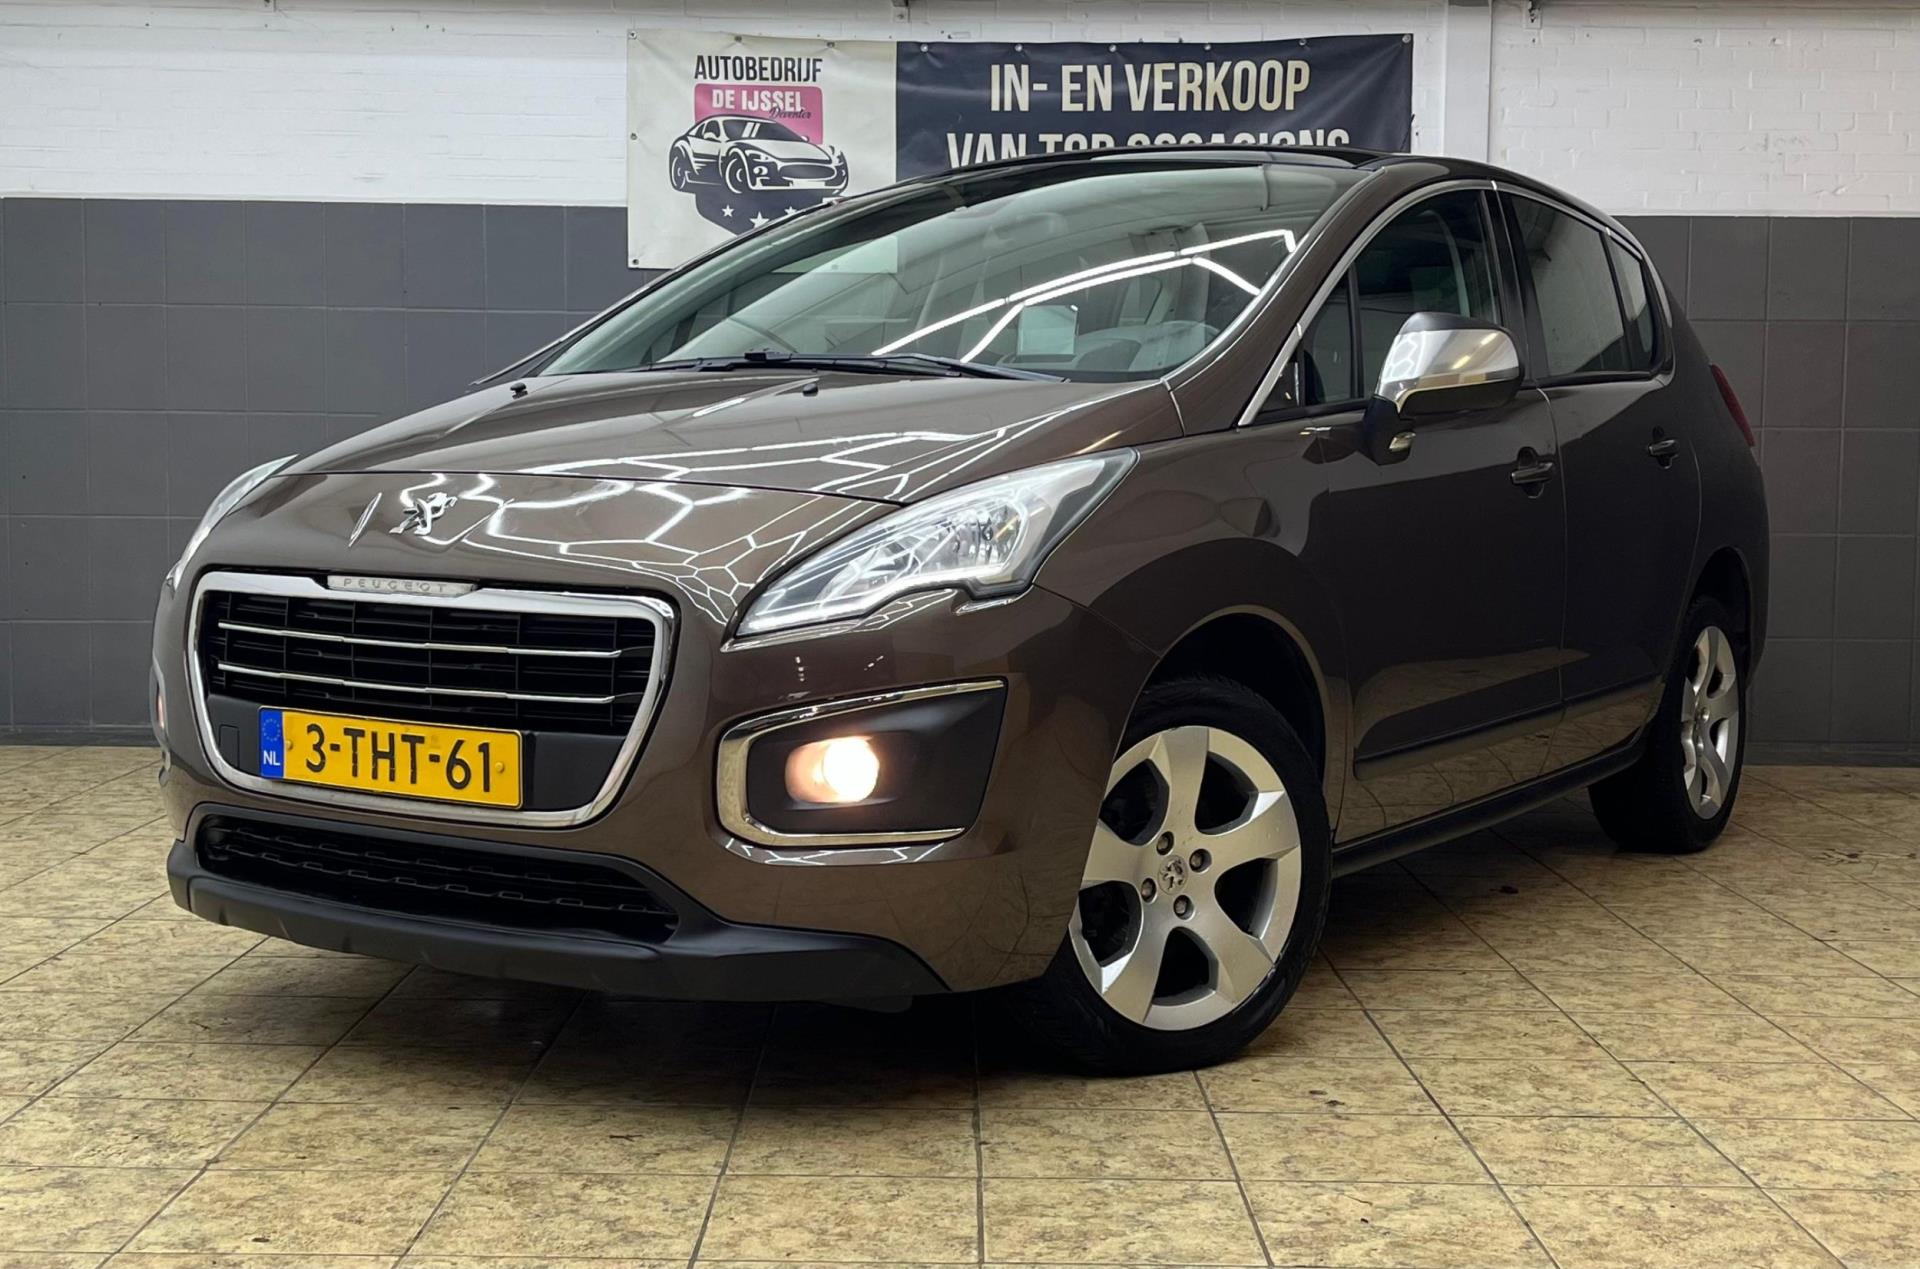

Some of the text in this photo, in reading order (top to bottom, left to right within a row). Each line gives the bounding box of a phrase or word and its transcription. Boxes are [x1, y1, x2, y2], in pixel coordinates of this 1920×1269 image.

[694, 55, 823, 82] AUTOBEDRIJF
[991, 59, 1311, 112] IN- EN VERKOOP
[712, 89, 805, 112] DE IJSSEL
[343, 577, 447, 593] PEUGEOT
[263, 749, 281, 767] NL
[306, 723, 491, 793] 3-THT-61
